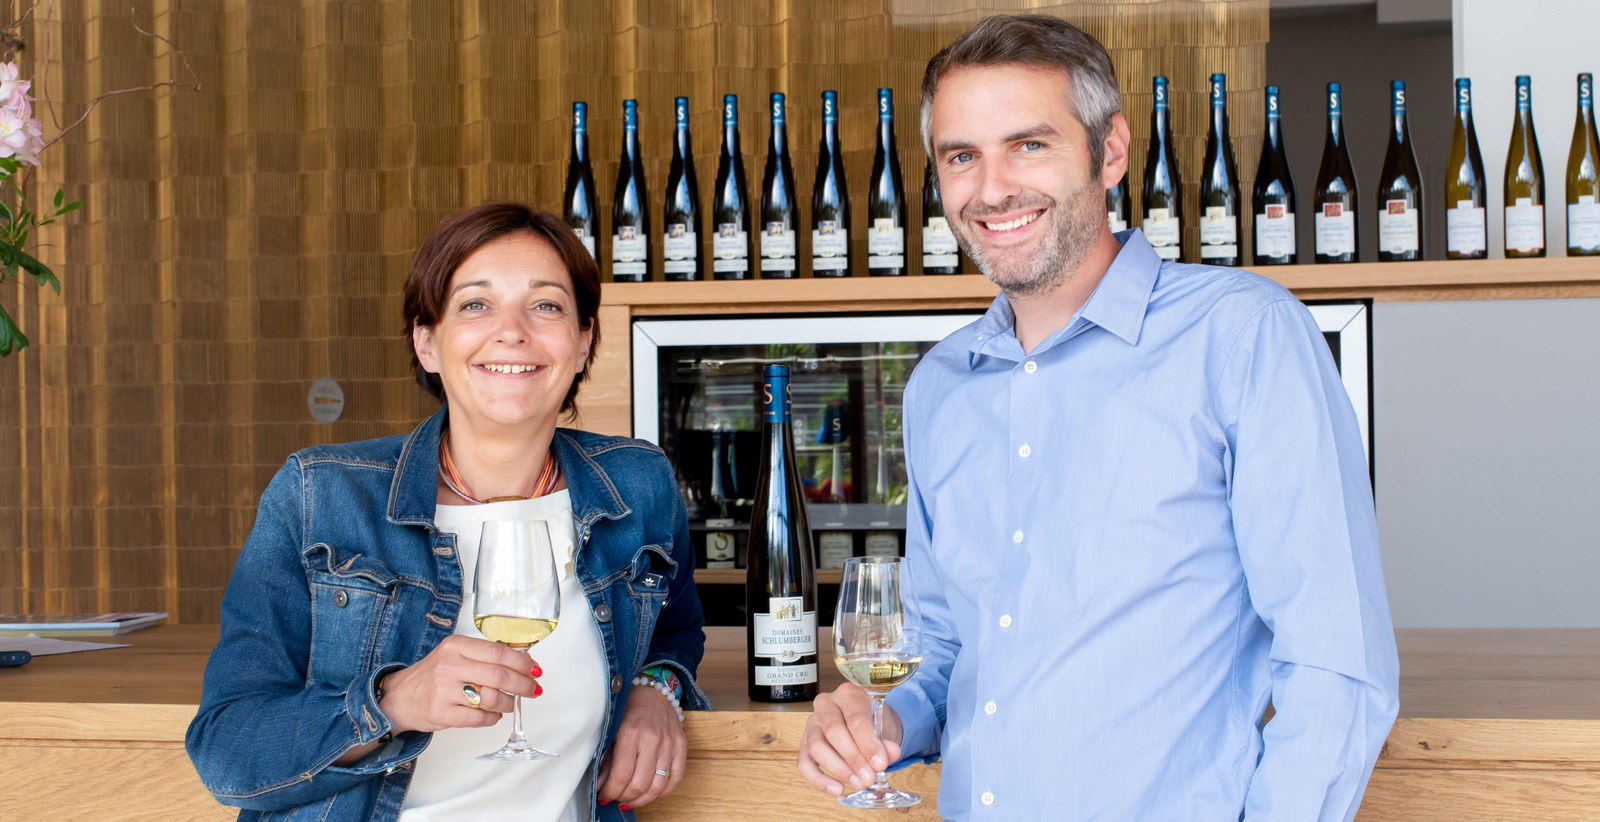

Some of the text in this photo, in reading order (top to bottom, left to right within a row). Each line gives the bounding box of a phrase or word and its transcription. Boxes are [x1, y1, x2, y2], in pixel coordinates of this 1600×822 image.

[1156, 86, 1164, 101] S
[1213, 83, 1220, 98] S
[1396, 90, 1405, 105] S
[1460, 88, 1469, 103] S
[1519, 86, 1528, 101] S
[1580, 83, 1590, 98] S
[825, 99, 832, 115] S
[880, 97, 887, 113] S
[1269, 96, 1277, 111] S
[1330, 92, 1337, 109] S
[677, 106, 684, 121] S
[726, 104, 732, 119] S
[773, 102, 781, 117] S
[763, 383, 773, 405] S
[832, 417, 841, 431] S
[762, 635, 811, 645] SCHLUMBERGER
